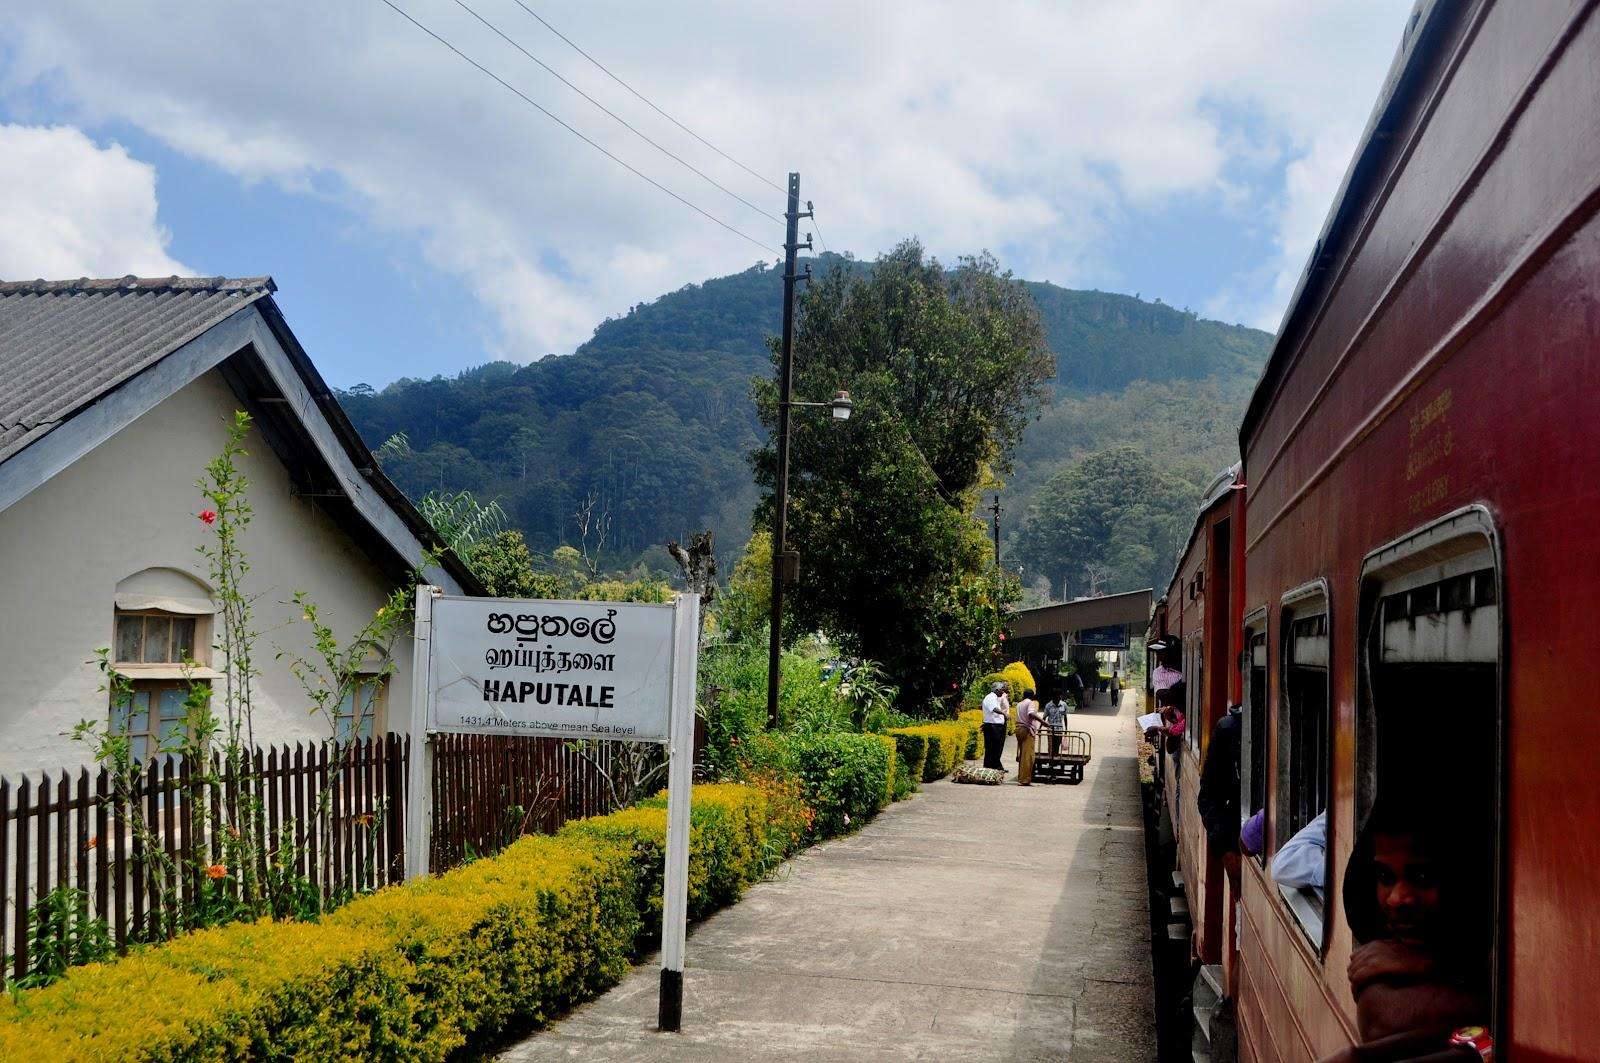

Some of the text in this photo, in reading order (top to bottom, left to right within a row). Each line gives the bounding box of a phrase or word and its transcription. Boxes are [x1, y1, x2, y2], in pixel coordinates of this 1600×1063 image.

[487, 609, 617, 644] හපුතලේ
[486, 643, 616, 673] ஹப்புத்தளை
[484, 680, 615, 708] HAPUTALE
[494, 717, 527, 728] Meters
[530, 720, 559, 730] above
[561, 723, 588, 732] mean
[591, 723, 610, 733] Sea
[613, 725, 636, 735] level
